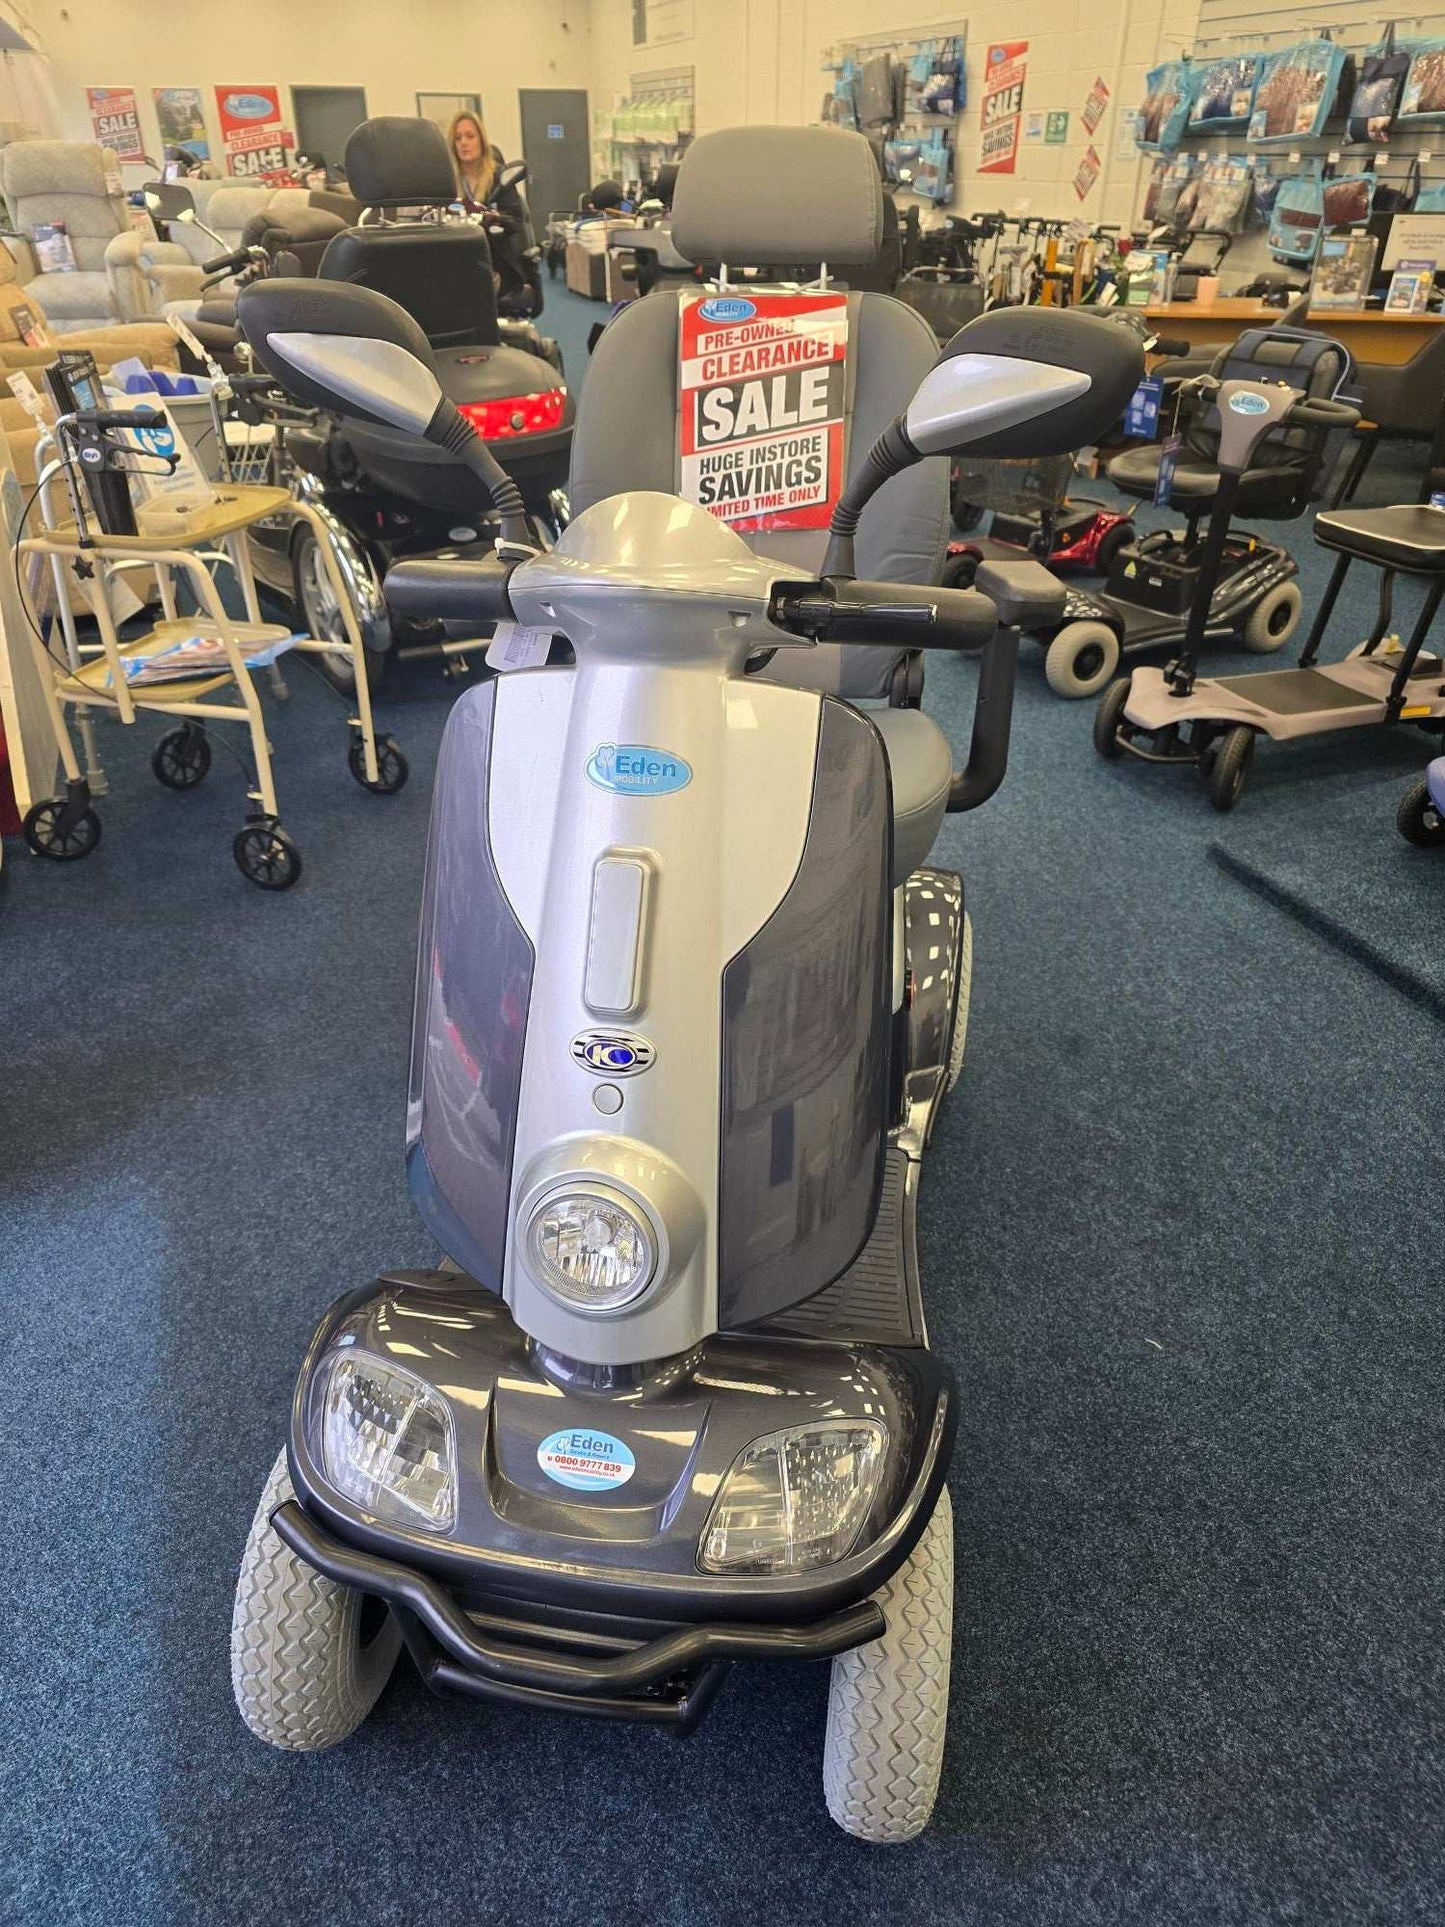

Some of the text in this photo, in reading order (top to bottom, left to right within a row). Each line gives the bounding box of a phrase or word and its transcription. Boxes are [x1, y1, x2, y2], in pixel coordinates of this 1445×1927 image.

[984, 85, 1021, 124] SALE
[99, 112, 137, 134] SALE
[233, 147, 283, 176] SALE
[716, 302, 747, 313] Eden
[702, 340, 829, 381] CLEARANCE
[702, 366, 830, 442] SALE
[700, 435, 822, 475] HUGE INSTORE
[698, 455, 822, 505] SAVINGS
[706, 484, 822, 518] MITED TIME ONLY
[615, 775, 659, 785] MOBILITY
[616, 756, 676, 777] Eden
[570, 1434, 614, 1454] Eden
[555, 1455, 622, 1473] 0800 9777 839
